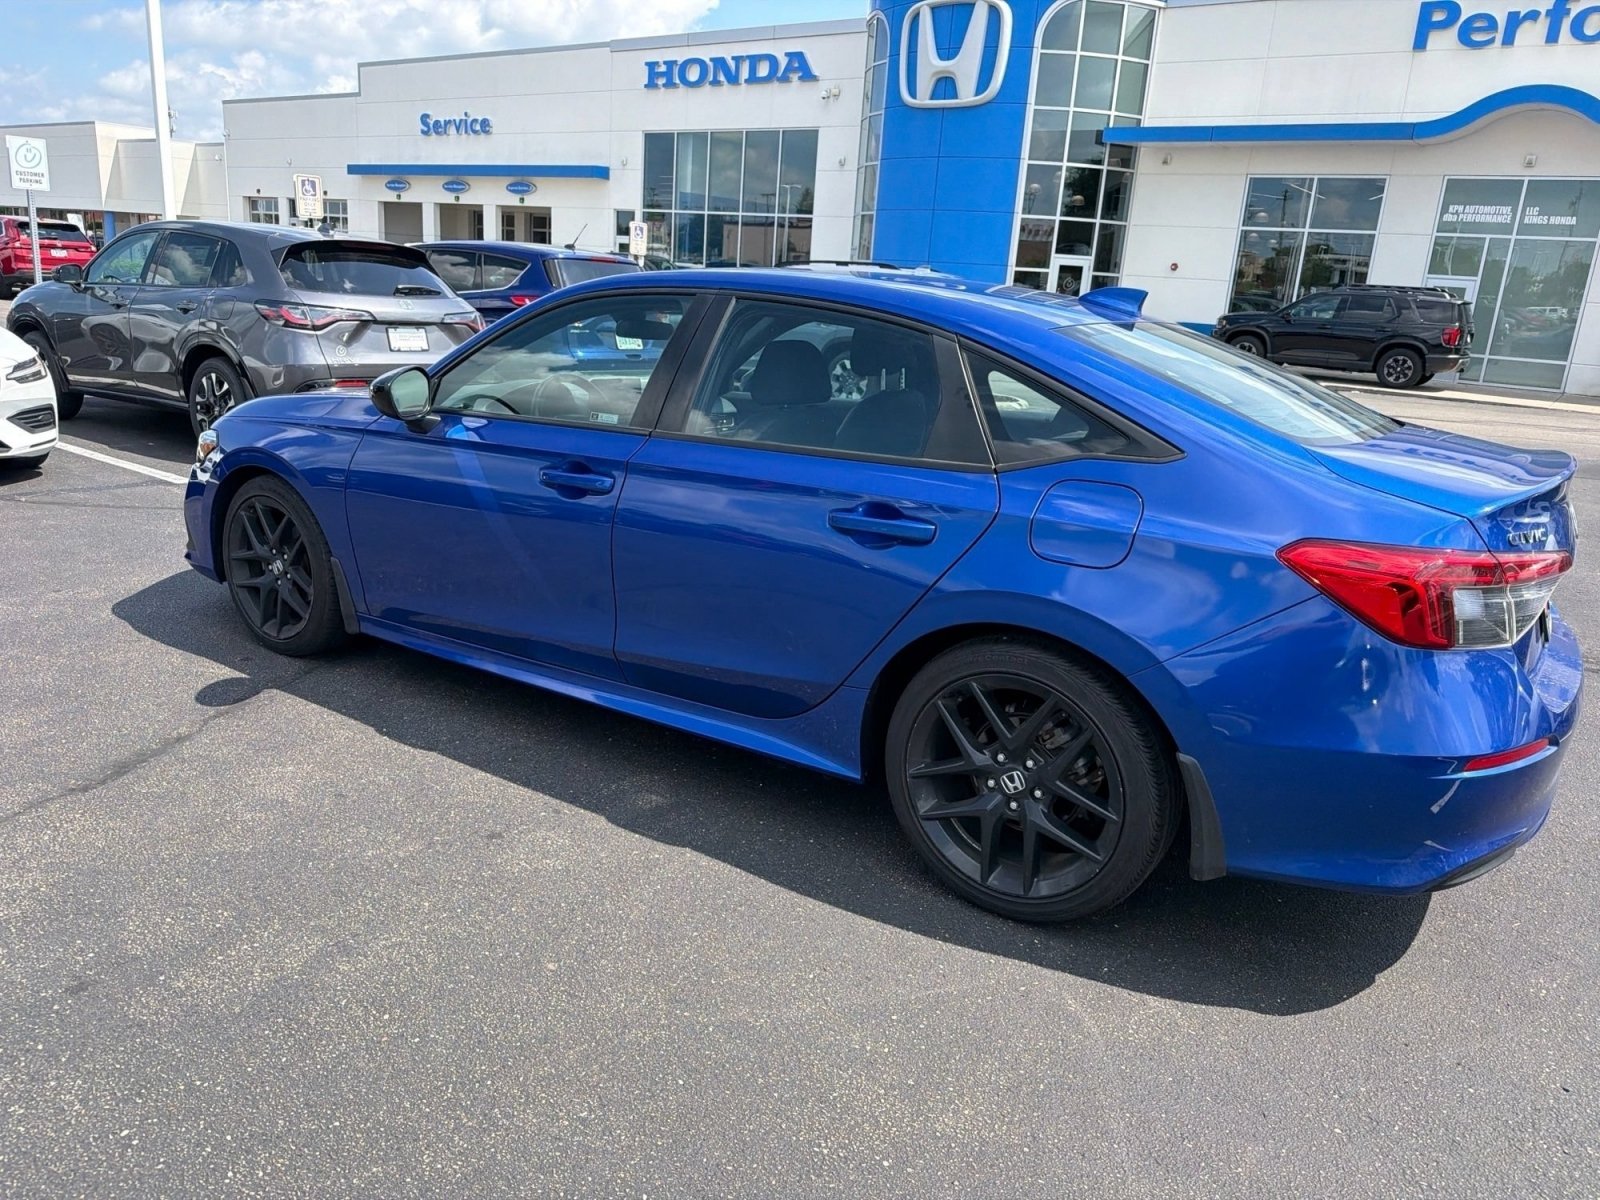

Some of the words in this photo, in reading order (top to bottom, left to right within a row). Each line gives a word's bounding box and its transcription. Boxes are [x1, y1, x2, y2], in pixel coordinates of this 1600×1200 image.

[644, 51, 819, 88] HONDA
[419, 111, 493, 136] Service
[15, 170, 45, 178] CUSTOMER
[19, 177, 43, 185] PARKING
[1448, 204, 1464, 213] KPH
[1525, 206, 1540, 215] LLC
[1442, 213, 1458, 222] dba
[1458, 213, 1512, 224] PERFORMANCE
[1523, 215, 1548, 225] KINGS
[1548, 216, 1577, 225] HONDA
[1507, 528, 1547, 546] CIVIC
